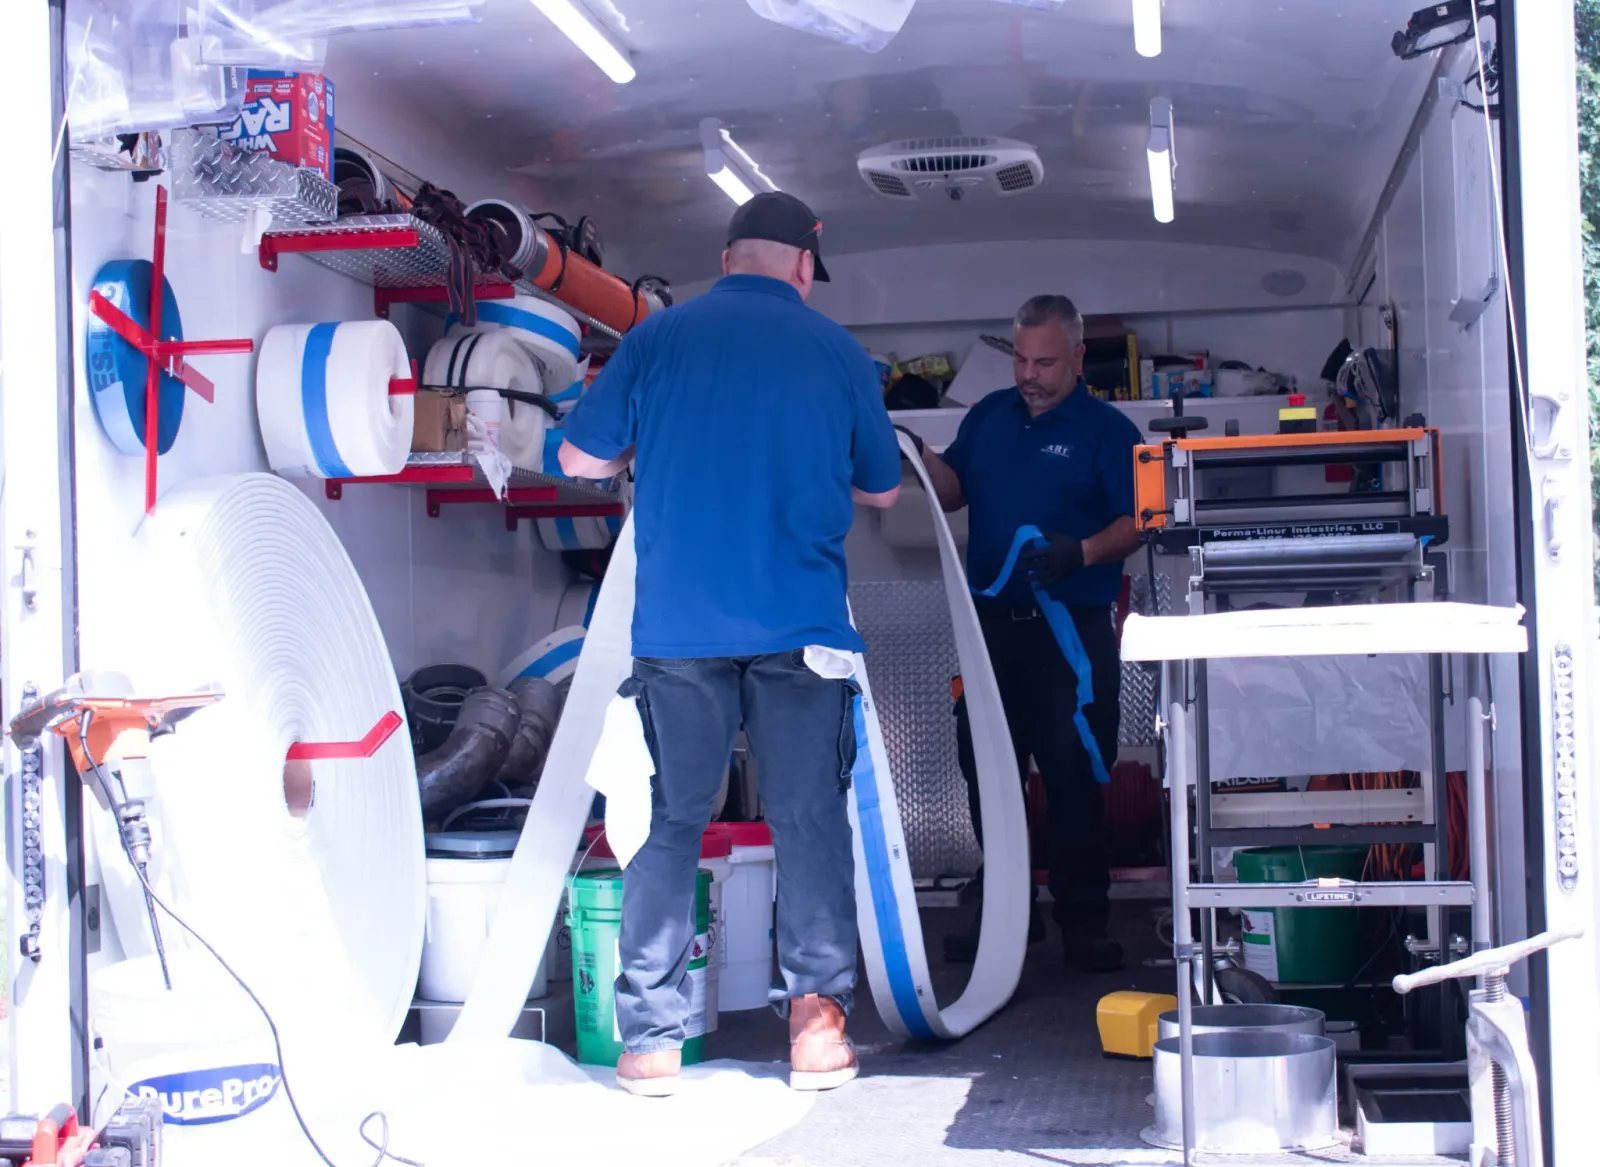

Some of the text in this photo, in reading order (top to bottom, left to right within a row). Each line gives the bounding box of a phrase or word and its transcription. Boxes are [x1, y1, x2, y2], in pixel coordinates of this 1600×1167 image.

[1213, 528, 1287, 538] Perma-Liner
[1291, 524, 1357, 534] Industries,
[1362, 523, 1384, 531] LLC
